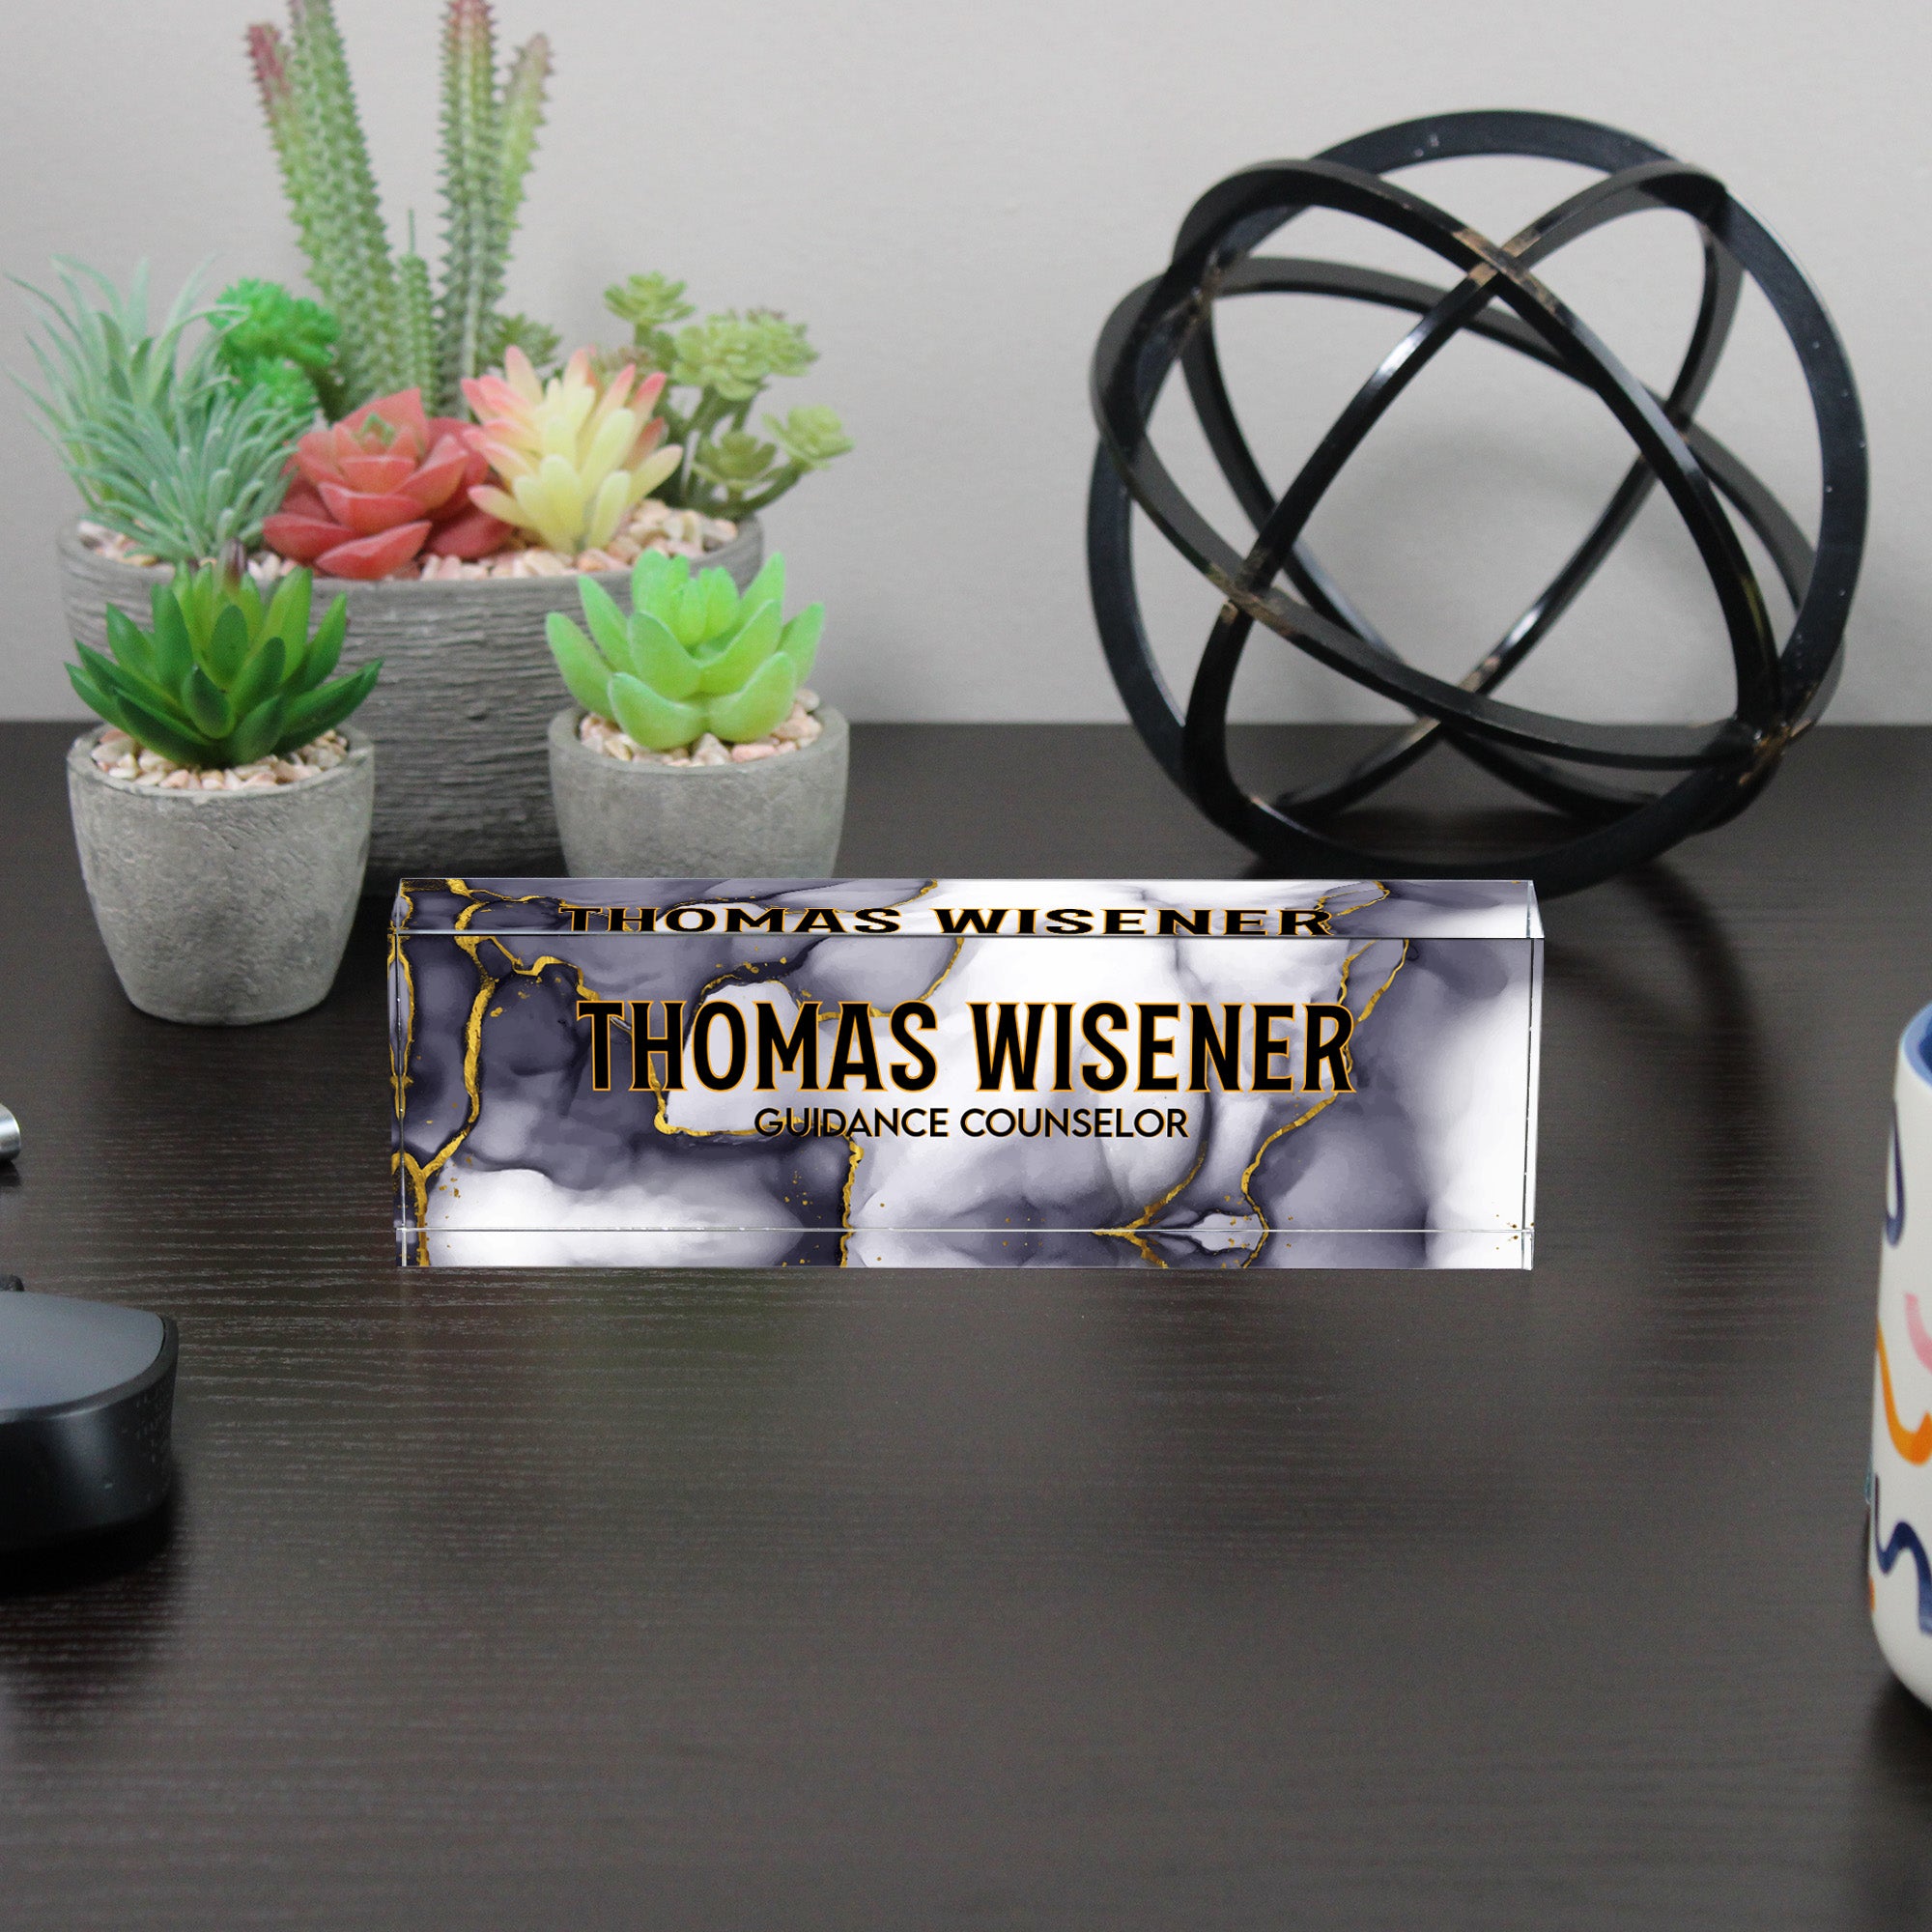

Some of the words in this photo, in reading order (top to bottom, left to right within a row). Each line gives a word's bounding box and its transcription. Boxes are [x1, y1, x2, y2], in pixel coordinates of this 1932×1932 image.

[559, 907, 901, 933] THOMAS
[934, 908, 1333, 935] WISENER
[577, 1000, 938, 1093] THOMAS
[968, 1001, 1356, 1093] WISENER
[754, 1108, 949, 1138] GUIDANCE
[960, 1108, 1189, 1138] COUNSELOR
